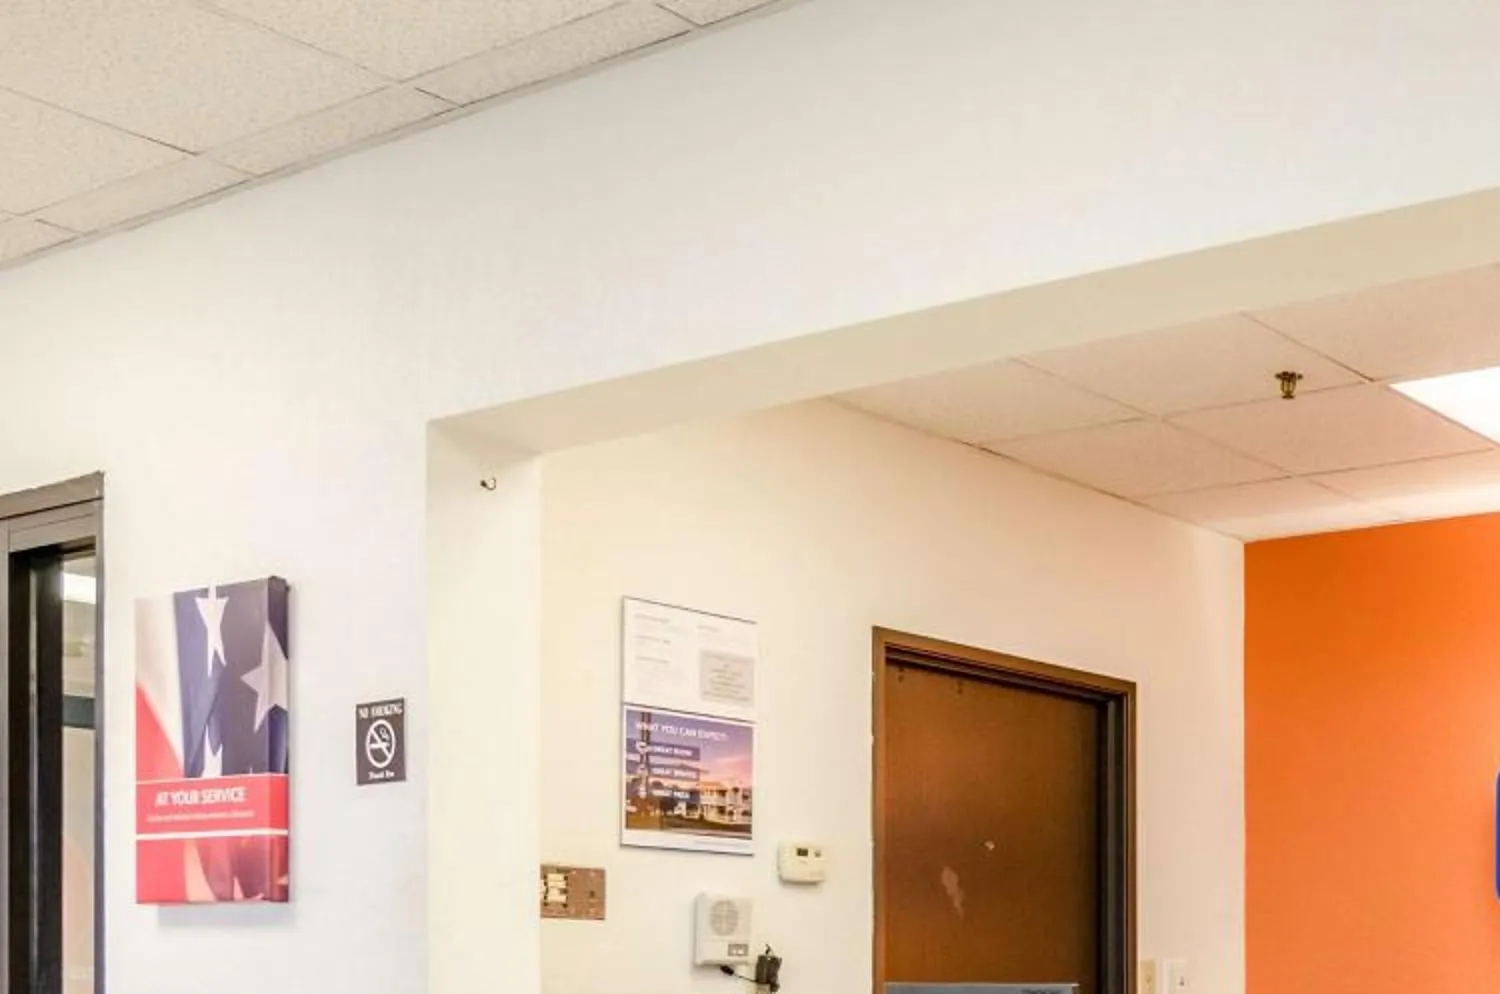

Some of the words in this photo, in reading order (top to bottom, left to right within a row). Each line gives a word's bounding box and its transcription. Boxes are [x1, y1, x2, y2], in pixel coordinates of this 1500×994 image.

[662, 725, 678, 735] YOU
[680, 728, 697, 737] CAN
[155, 790, 170, 806] AT
[172, 788, 200, 805] YOUR
[201, 785, 248, 804] SERVICE
